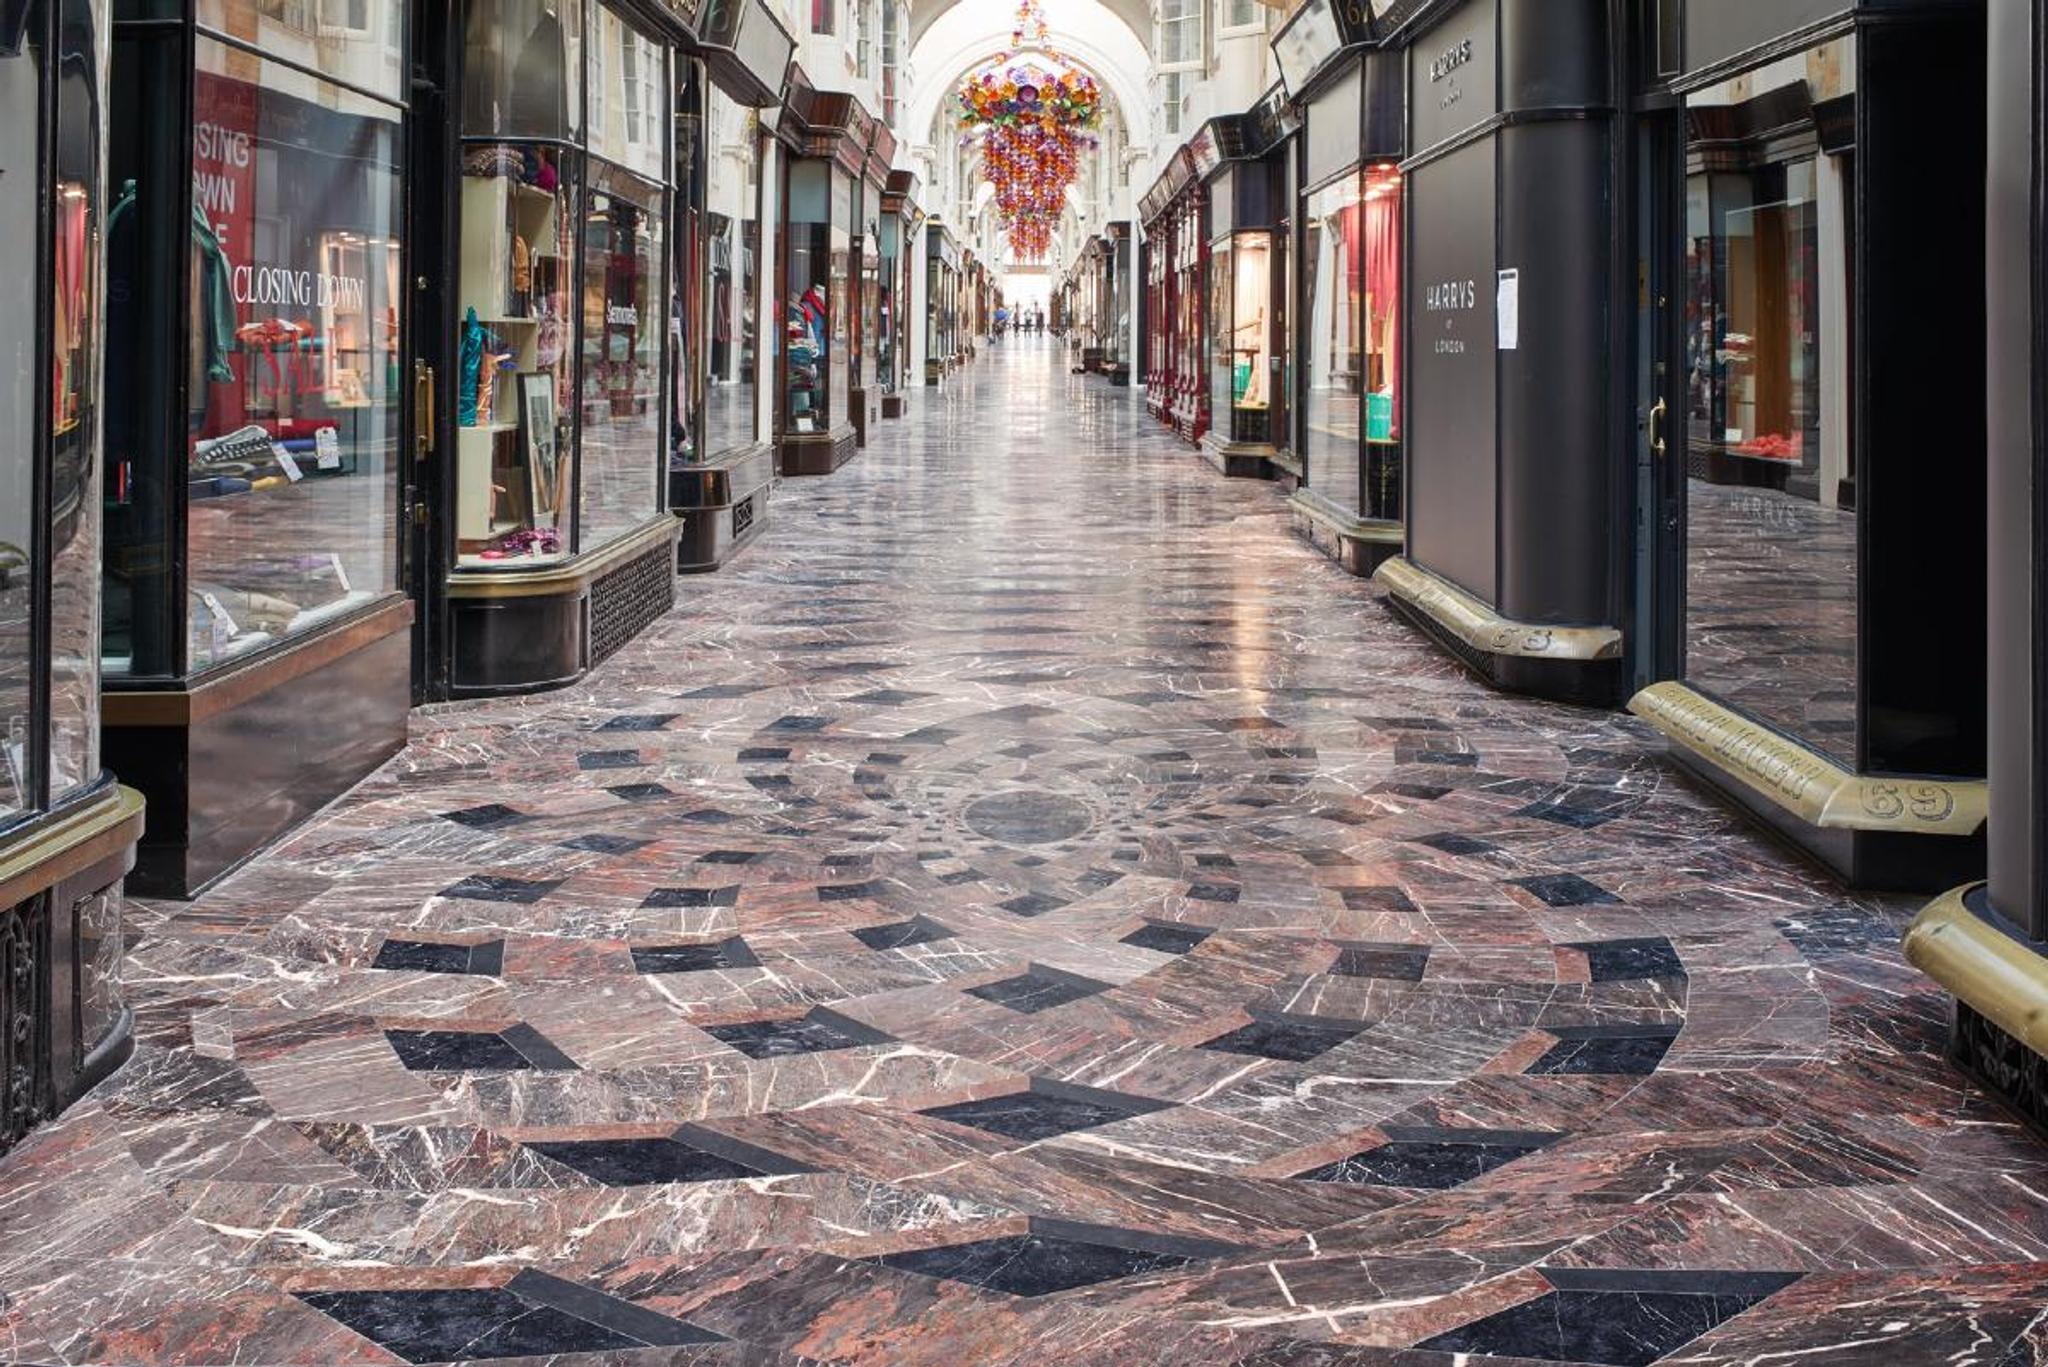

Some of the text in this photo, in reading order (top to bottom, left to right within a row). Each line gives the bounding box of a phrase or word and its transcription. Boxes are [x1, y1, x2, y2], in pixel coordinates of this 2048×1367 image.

[193, 121, 249, 168] SING
[233, 265, 365, 310] CLOSING DOWN
[1427, 279, 1475, 311] HARRYS
[260, 327, 344, 397] SALE
[1860, 782, 1955, 822] 69
